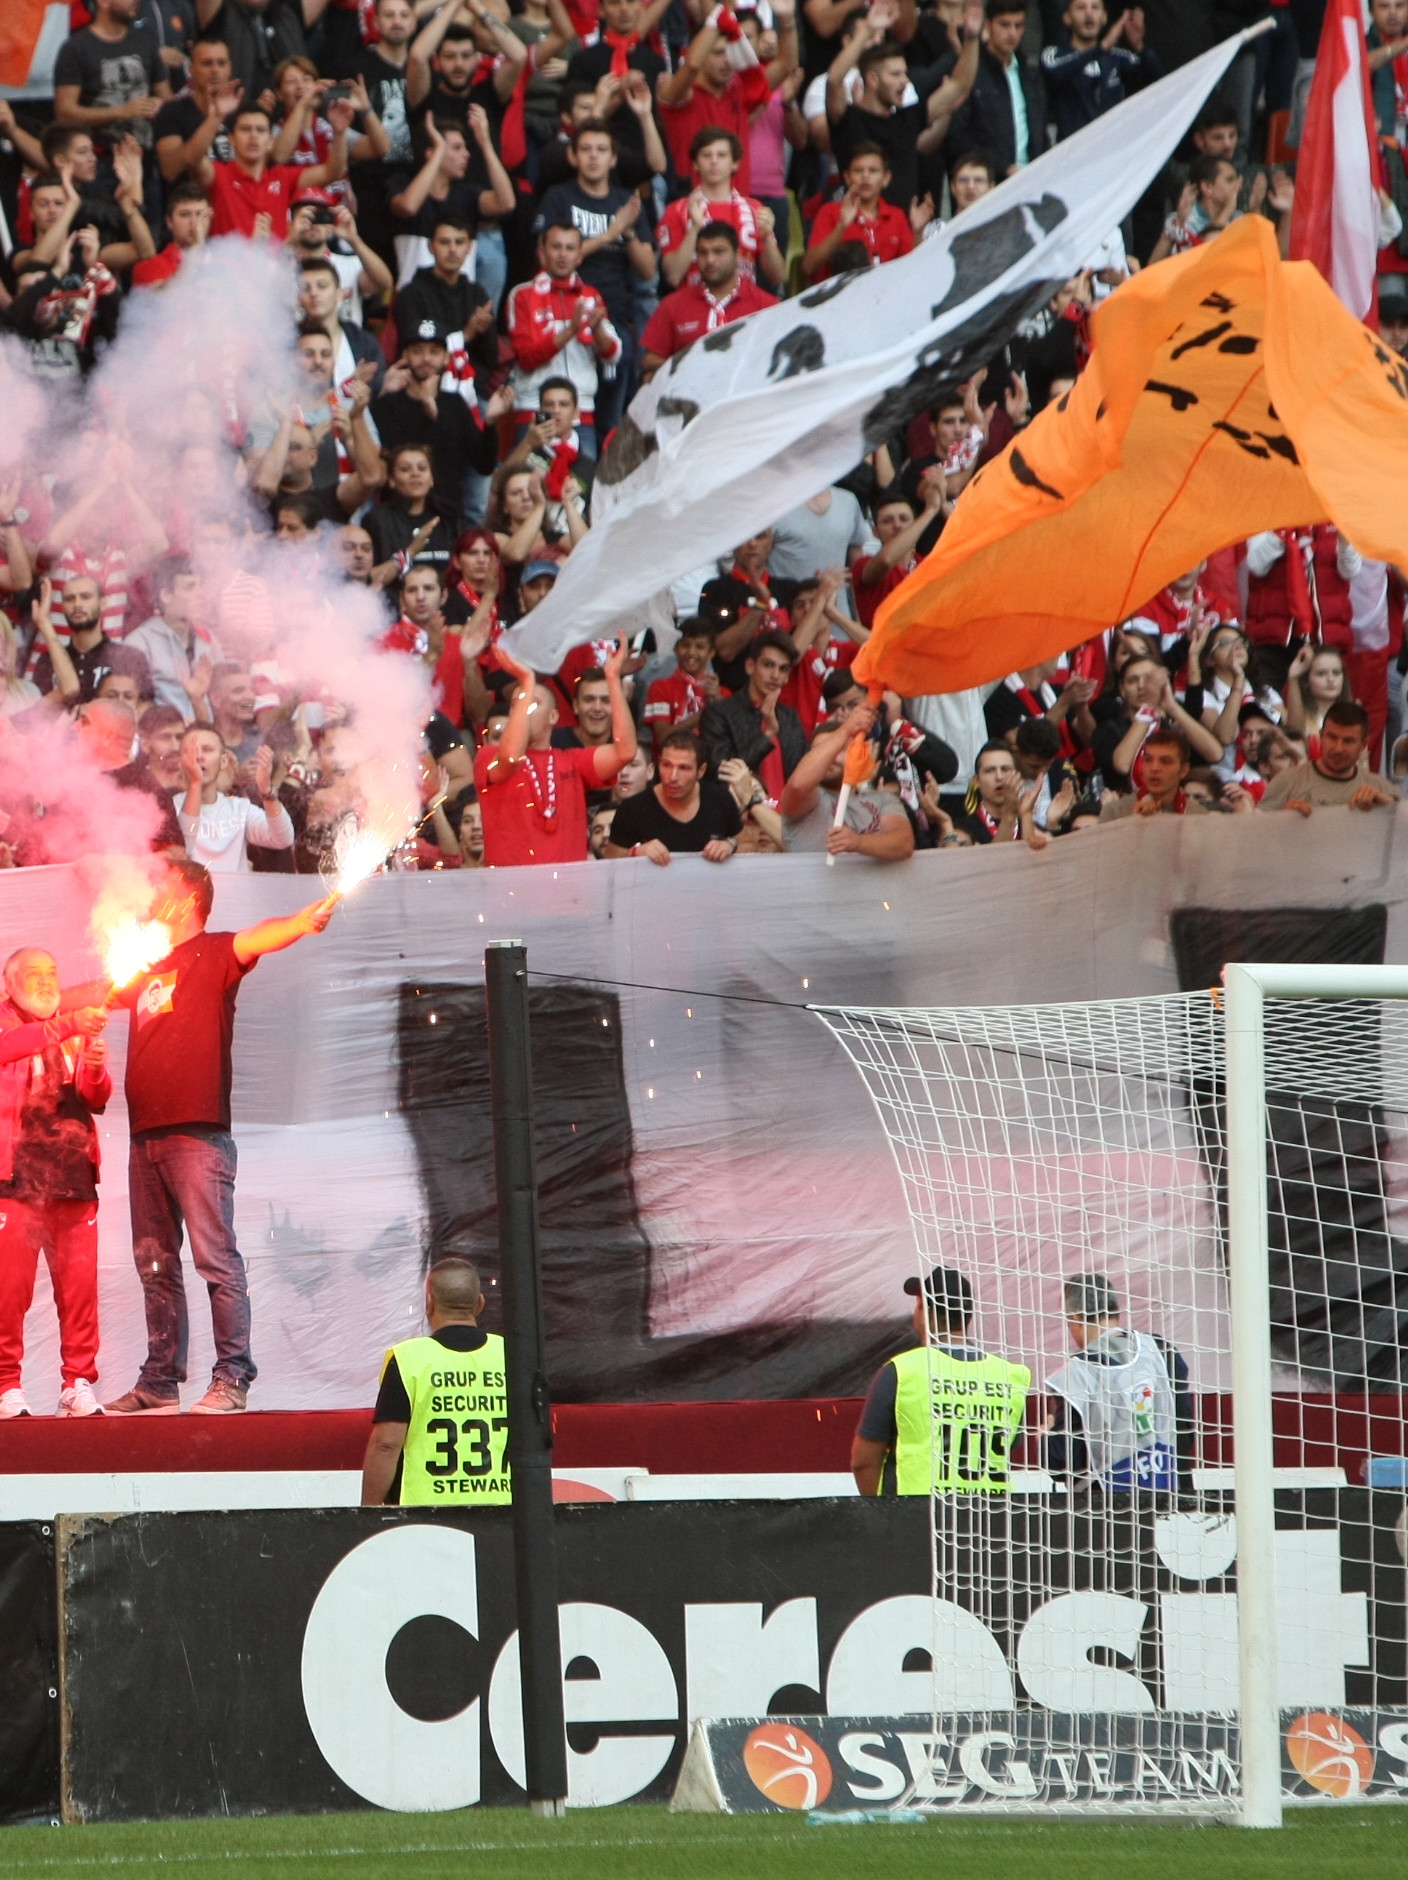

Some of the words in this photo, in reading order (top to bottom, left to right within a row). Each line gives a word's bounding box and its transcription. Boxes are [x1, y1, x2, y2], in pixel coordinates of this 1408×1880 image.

[430, 1371, 477, 1388] GRUP
[482, 1371, 506, 1388] ES
[931, 1378, 979, 1396] GRUP
[984, 1382, 1013, 1399] EST
[431, 1395, 507, 1412] SECURIT
[425, 1417, 509, 1477] 337
[433, 1479, 511, 1494] STEWAR
[301, 1512, 1370, 1812] Ceresit
